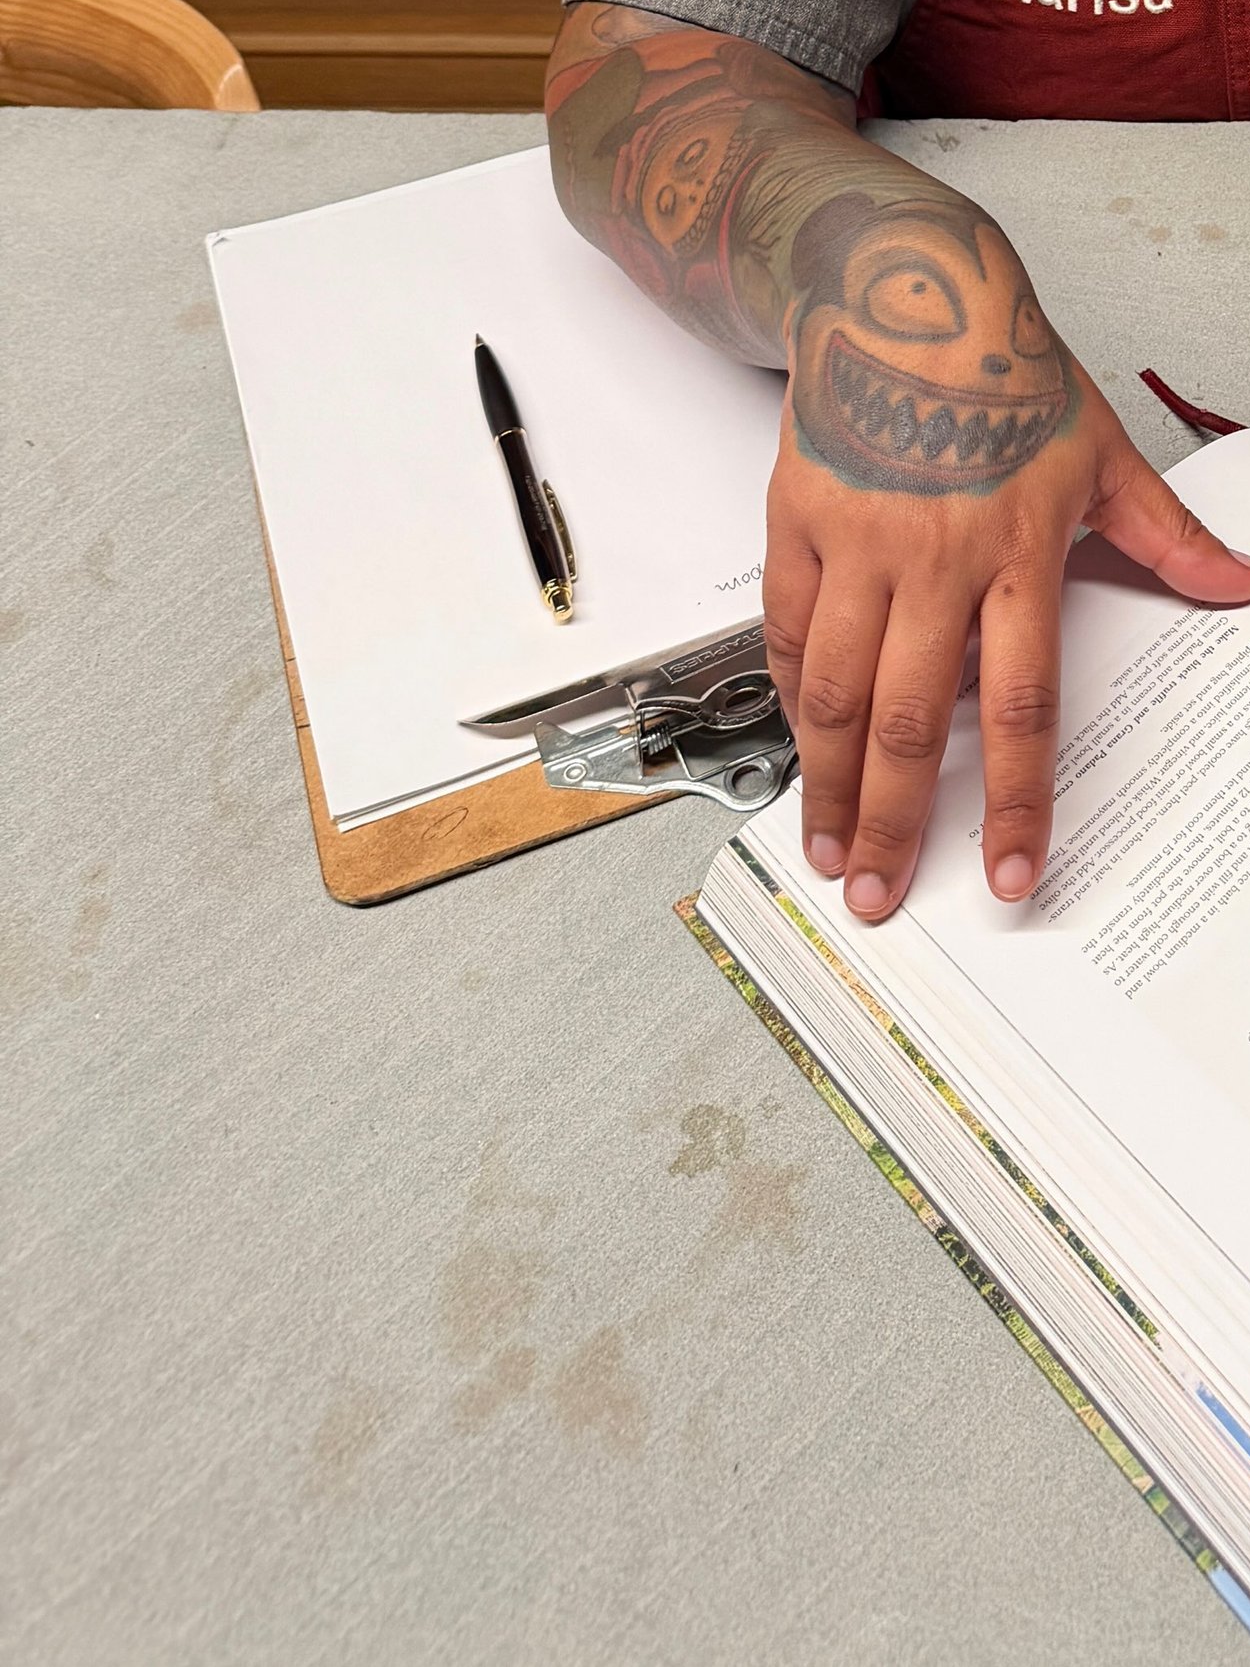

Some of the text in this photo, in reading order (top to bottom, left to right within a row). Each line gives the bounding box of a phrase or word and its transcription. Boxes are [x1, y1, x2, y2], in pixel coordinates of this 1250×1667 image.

[1075, 624, 1239, 778] Make the black truffle and Grana Padano
[1225, 729, 1247, 748] have
[1179, 774, 1198, 795] peel
[1141, 817, 1157, 832] cut
[1119, 831, 1143, 854] them
[1236, 831, 1247, 841] to
[1109, 853, 1122, 863] in
[1212, 848, 1232, 867] boil
[1230, 851, 1248, 871] and
[1194, 866, 1213, 886] over
[1218, 869, 1233, 884] fill
[1073, 880, 1091, 900] and
[1199, 881, 1220, 901] with
[1217, 884, 1240, 905] bath
[1047, 897, 1074, 923] trans-
[1137, 884, 1194, 941] medium-high
[1167, 901, 1200, 933] enough
[1207, 905, 1220, 915] in
[1148, 933, 1168, 954] cold
[1164, 922, 1200, 958] medium
[1102, 961, 1116, 975] As
[1125, 952, 1150, 977] water
[1142, 958, 1167, 982] bowl
[1114, 975, 1125, 986] to
[1124, 979, 1143, 999] and
